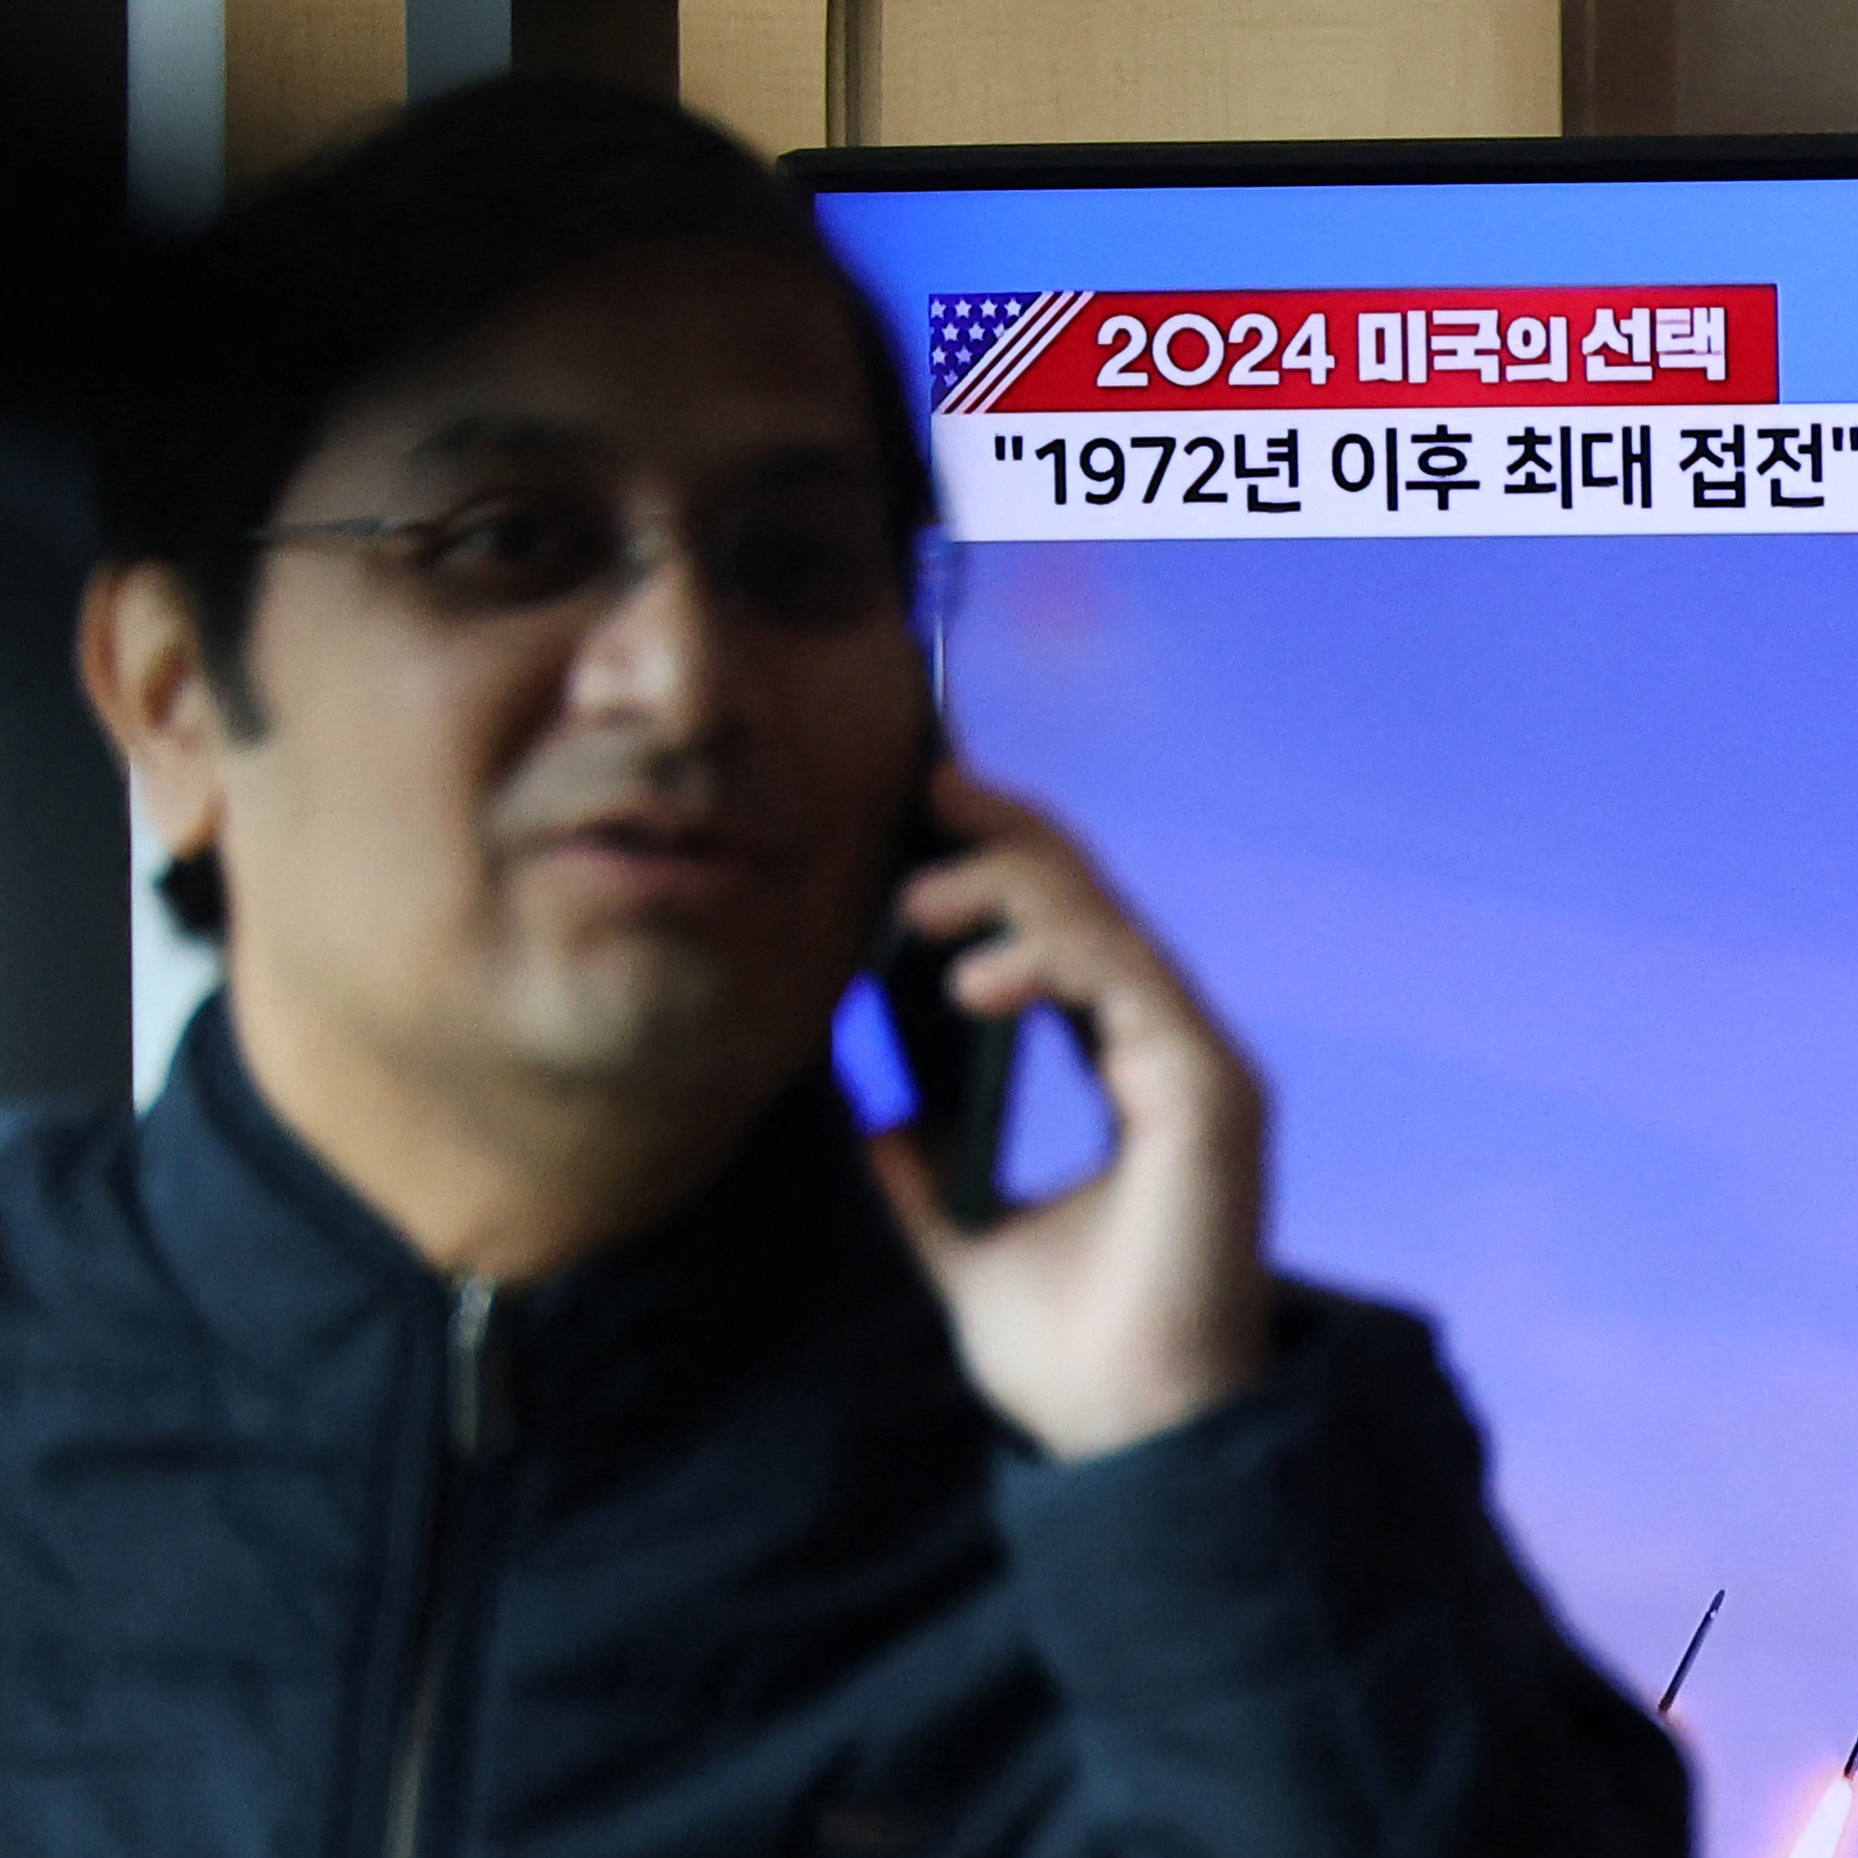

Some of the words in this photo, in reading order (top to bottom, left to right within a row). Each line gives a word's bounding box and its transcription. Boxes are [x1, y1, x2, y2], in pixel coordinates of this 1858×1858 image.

[1096, 312, 1334, 387] 2024
[1357, 310, 1568, 383] 미국의
[1579, 306, 1726, 381] 선택
[993, 430, 1302, 514] "1972년
[1331, 424, 1480, 511] 이후
[1503, 424, 1653, 510] 최대
